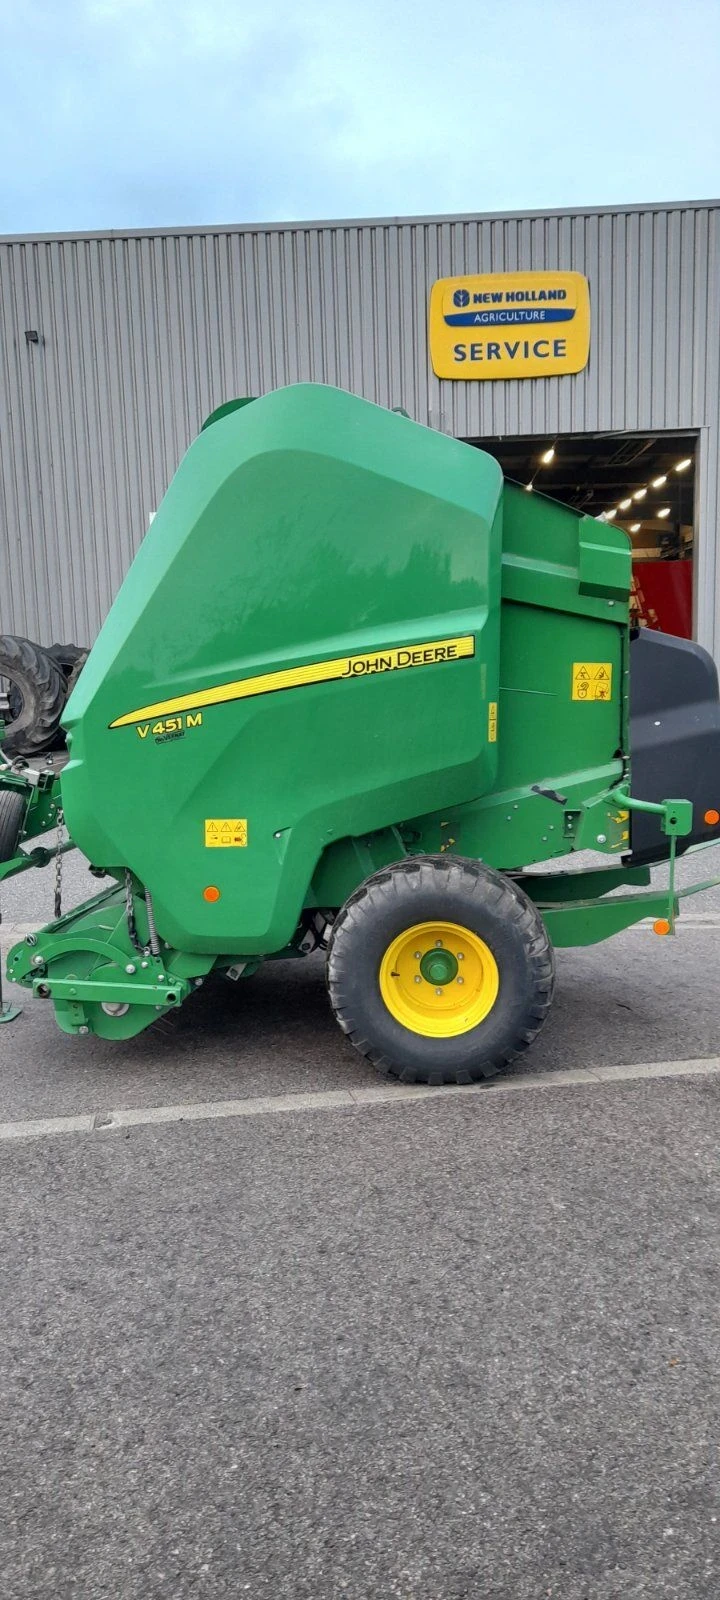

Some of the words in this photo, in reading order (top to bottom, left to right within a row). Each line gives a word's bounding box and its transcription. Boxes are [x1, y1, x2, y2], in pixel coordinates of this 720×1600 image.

[473, 292, 503, 304] NEW
[506, 289, 567, 303] HOLLAND
[474, 311, 546, 323] AGRICULTURE
[453, 339, 567, 362] SERVICE
[341, 656, 392, 676] JOHN
[397, 645, 458, 667] DEERE
[137, 725, 150, 738] V
[152, 717, 182, 734] 451
[186, 712, 202, 728] M
